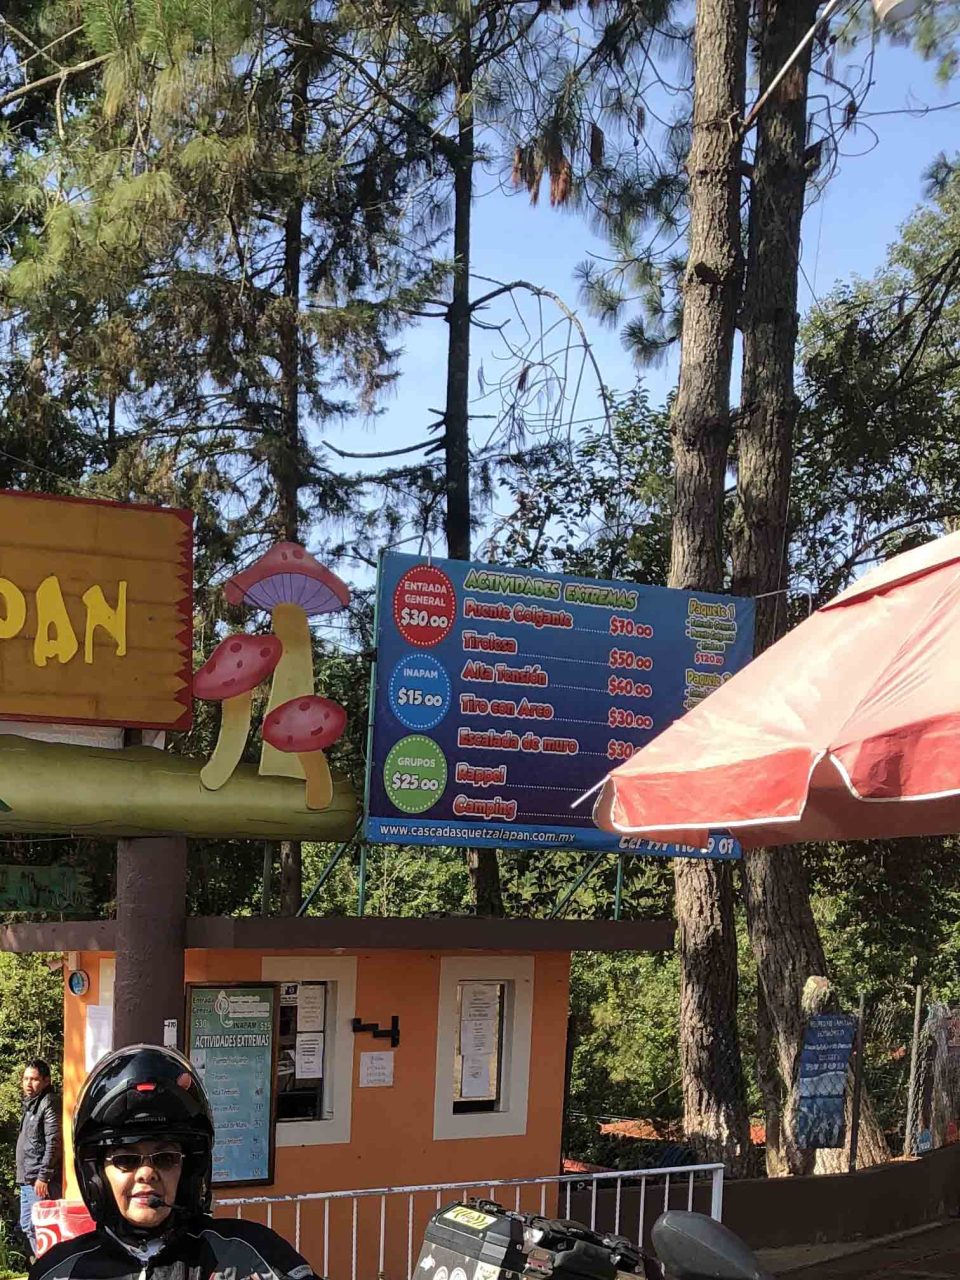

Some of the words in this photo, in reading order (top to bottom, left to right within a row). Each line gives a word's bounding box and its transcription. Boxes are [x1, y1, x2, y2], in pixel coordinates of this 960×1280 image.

[405, 581, 447, 594] ENTRADA
[463, 568, 561, 600] ACTIVIDADES
[564, 583, 639, 612] EXTREMAS
[405, 594, 446, 607] GENERAL
[688, 598, 728, 619] Paquete
[401, 607, 448, 628] $30.00
[464, 598, 511, 622] Puente
[512, 603, 574, 629] Colgante
[609, 615, 653, 639] $70.00
[462, 629, 517, 655] Tirolesa
[609, 648, 653, 671] $50.00
[403, 668, 438, 679] INAPAM
[460, 659, 494, 682] Alta
[495, 663, 548, 688] Tensión
[608, 675, 653, 698] $40.00
[398, 687, 442, 707] $15.00
[460, 693, 489, 715] Tiro
[490, 700, 516, 717] con
[516, 697, 554, 720] Arco
[608, 706, 653, 729] $30.00
[458, 727, 520, 749] Escalada
[521, 731, 541, 752] de
[542, 736, 579, 756] muro
[398, 757, 436, 768] GRUPOS
[392, 772, 439, 790] $25.00
[456, 761, 507, 787] Rappel
[453, 793, 517, 821] Camping
[380, 824, 576, 842] www.cascadasquetzalapan.com.mx
[195, 1034, 236, 1048] ACTIVIDADES
[237, 1033, 270, 1047] EXTREMAS
